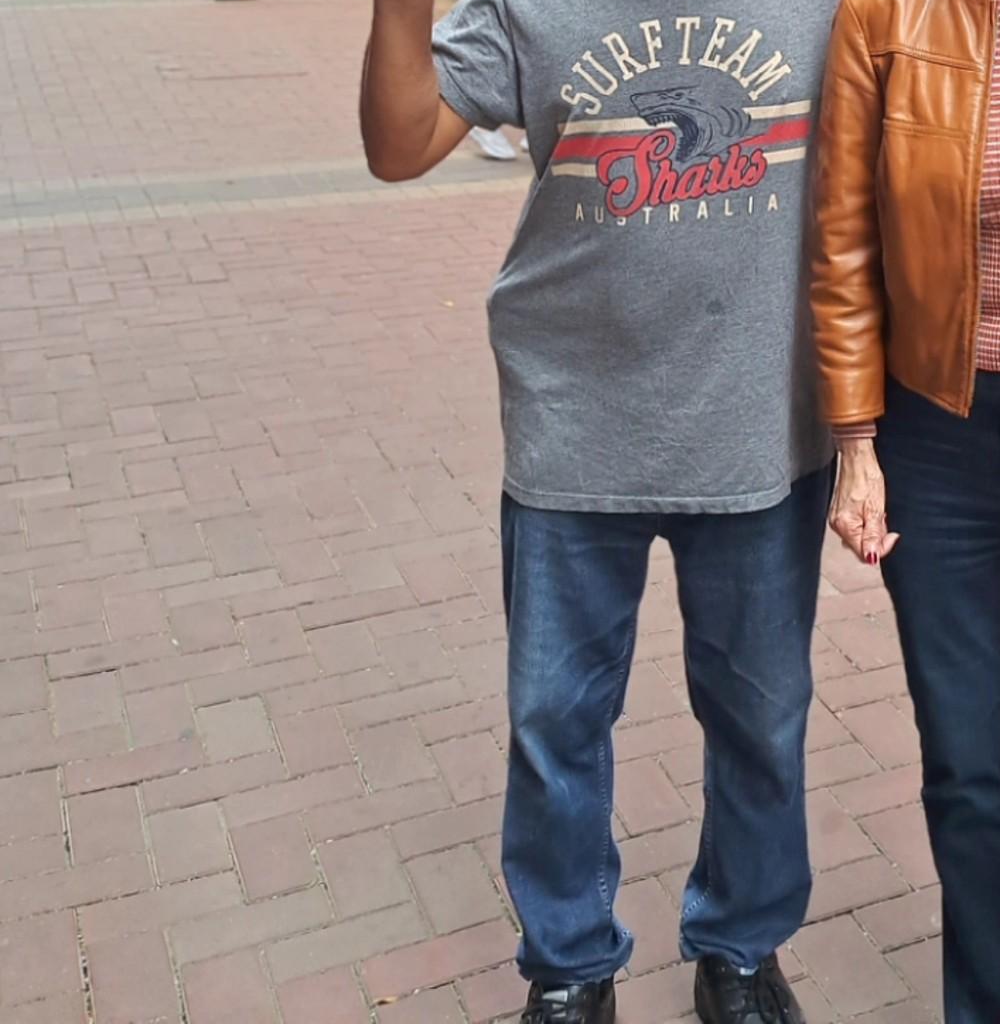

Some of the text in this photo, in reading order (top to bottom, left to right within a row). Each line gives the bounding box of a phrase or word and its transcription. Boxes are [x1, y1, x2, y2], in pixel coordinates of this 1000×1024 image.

[560, 16, 792, 116] SURF TEAM
[596, 129, 768, 219] Sharks
